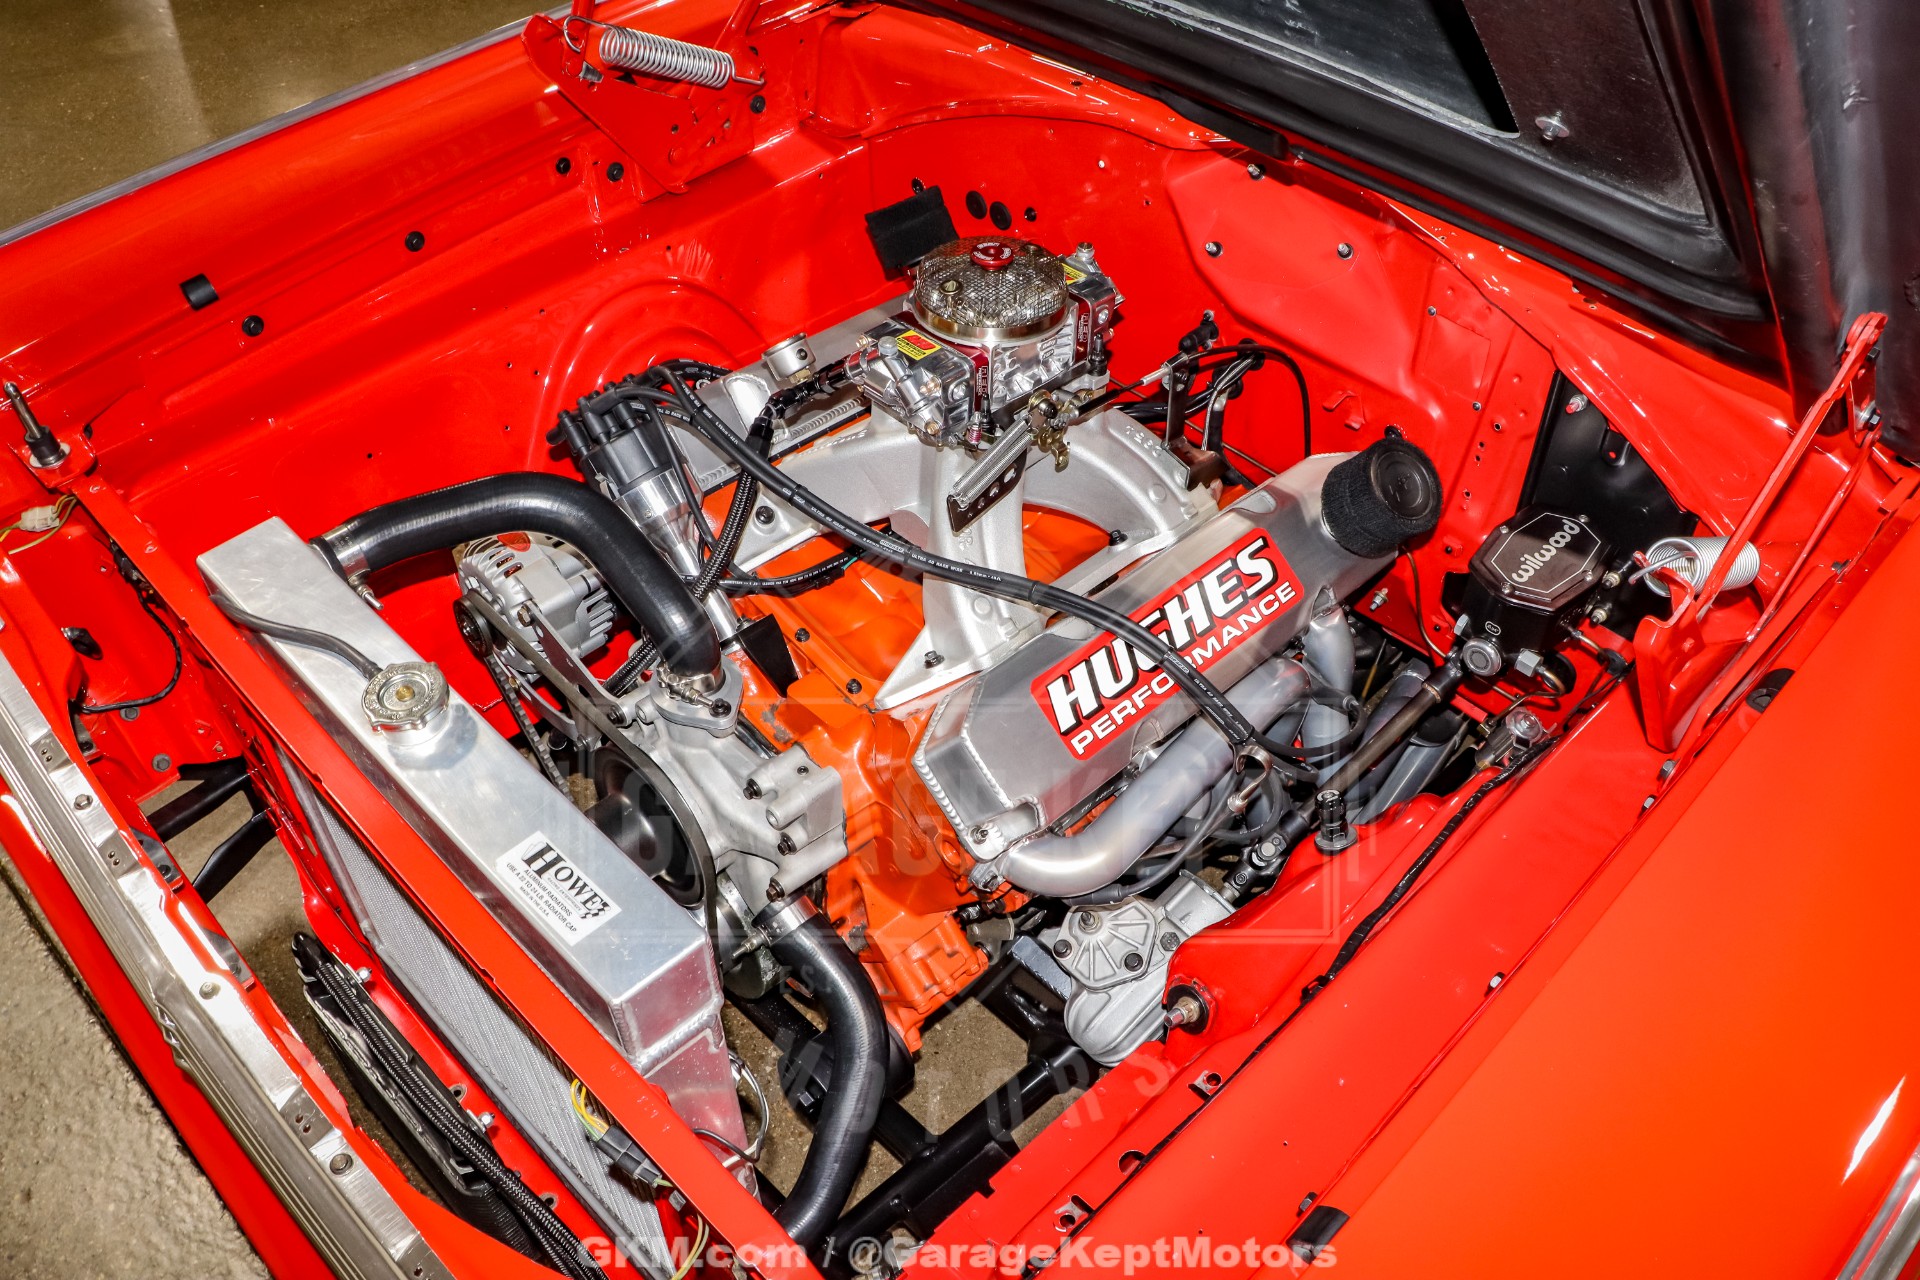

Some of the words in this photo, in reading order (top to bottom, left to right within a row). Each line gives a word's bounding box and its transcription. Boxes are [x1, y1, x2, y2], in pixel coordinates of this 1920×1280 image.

[1512, 519, 1580, 582] wilwood
[1070, 581, 1296, 756] PERFOMANCE
[506, 862, 517, 873] USE
[524, 880, 532, 889] TO
[542, 899, 567, 923] RADIATOR
[564, 921, 577, 934] CAP
[522, 842, 607, 911] HOWE
[523, 868, 547, 892] ALUMINUM
[545, 890, 572, 917] RADIATORS
